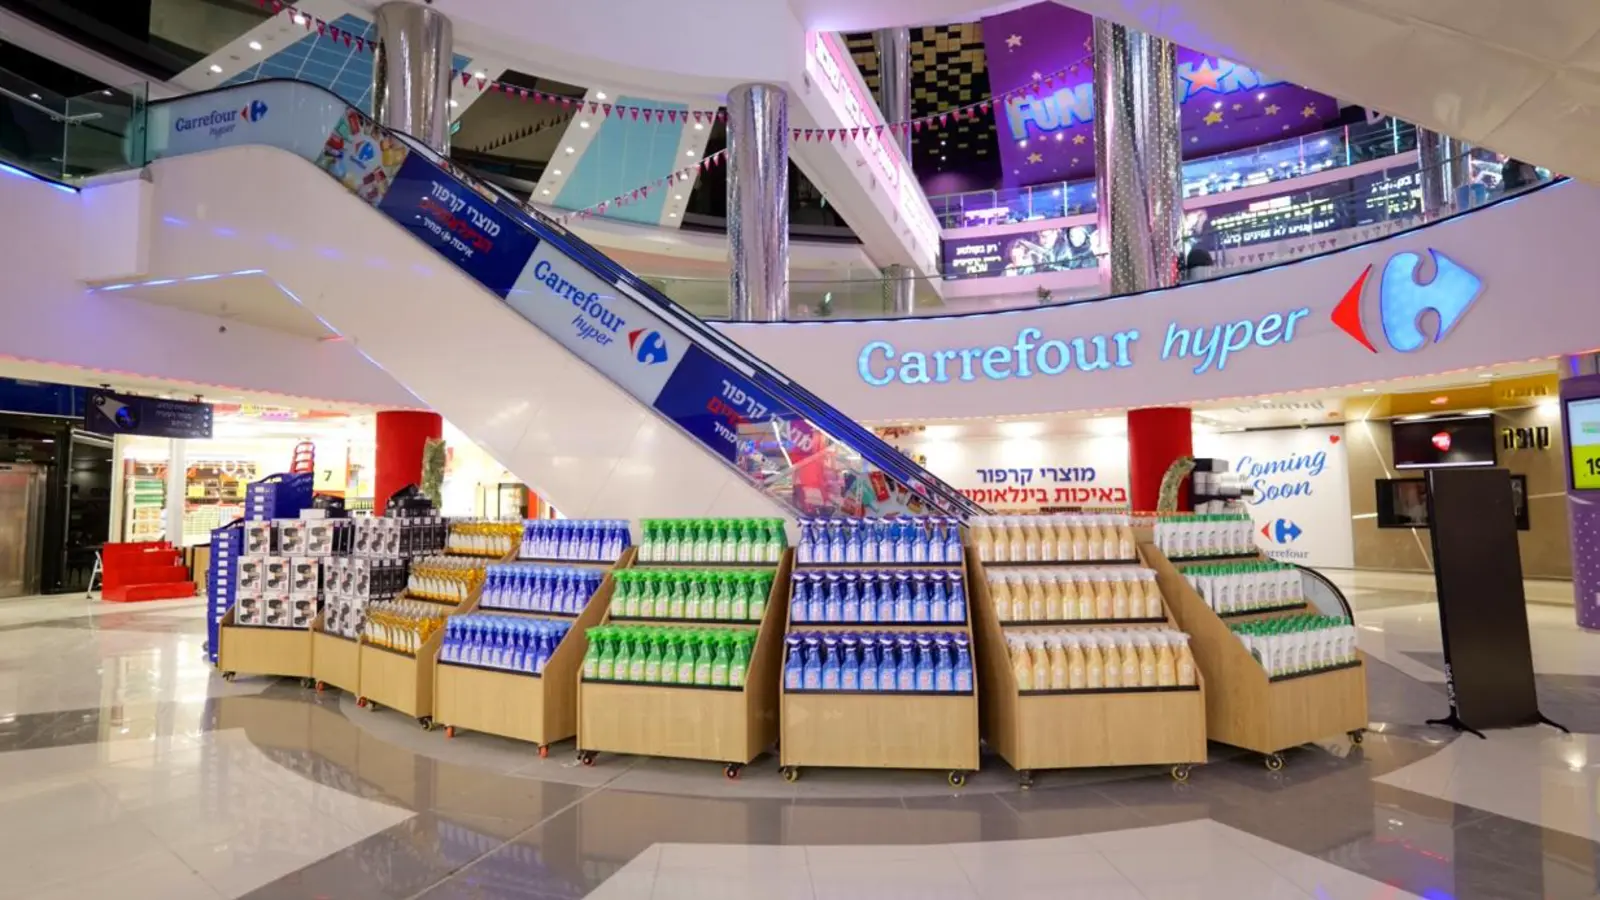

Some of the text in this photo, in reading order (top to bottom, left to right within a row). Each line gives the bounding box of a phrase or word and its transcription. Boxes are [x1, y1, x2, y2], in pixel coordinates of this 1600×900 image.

[175, 110, 237, 132] Carrefour
[431, 180, 467, 213] קרפור
[467, 205, 501, 237] מוצרי
[533, 260, 626, 333] Carrefour
[571, 313, 613, 346] hyper
[857, 306, 1310, 387] Carrefour hyper
[721, 379, 768, 419] קרפור
[1501, 425, 1551, 451] קופה
[976, 466, 1096, 486] מוצרי קרפור
[1235, 450, 1328, 480] Coming
[957, 486, 1128, 504] באיכות בינלאומי
[1249, 478, 1314, 506] Soon
